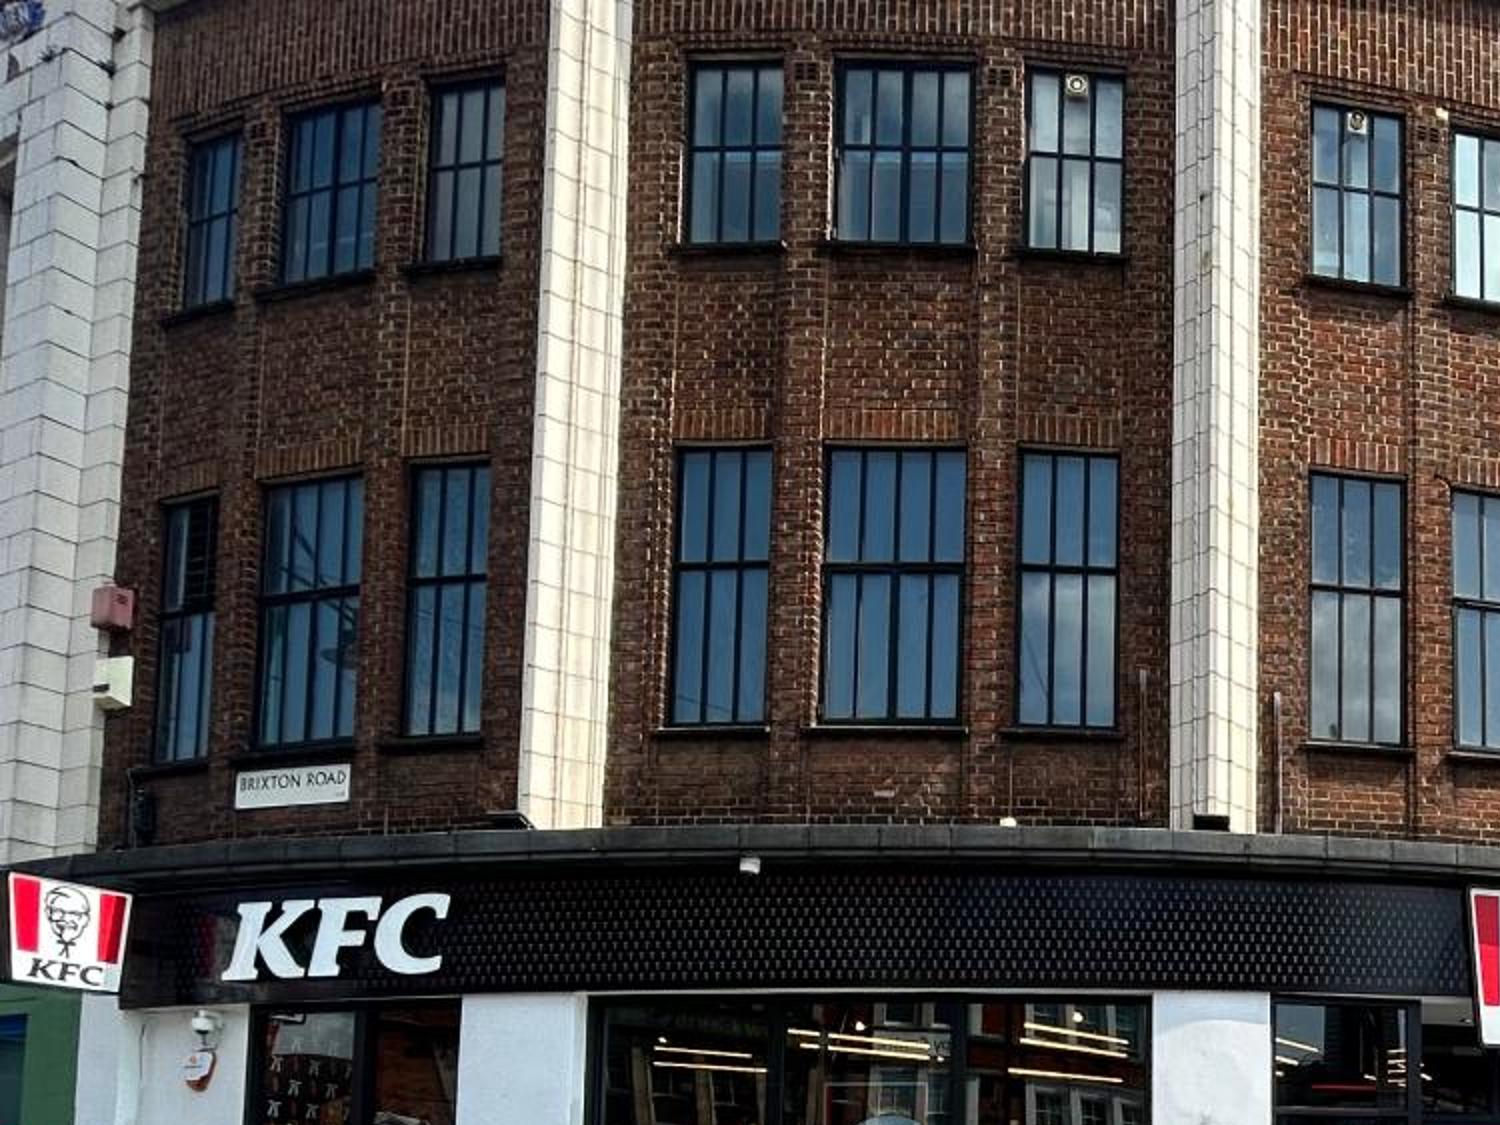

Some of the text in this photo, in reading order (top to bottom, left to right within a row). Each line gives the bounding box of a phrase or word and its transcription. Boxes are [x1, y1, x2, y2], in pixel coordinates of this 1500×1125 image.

[240, 770, 347, 791] BRIXTON ROAD
[221, 893, 451, 981] KFC
[28, 958, 103, 986] KFC
